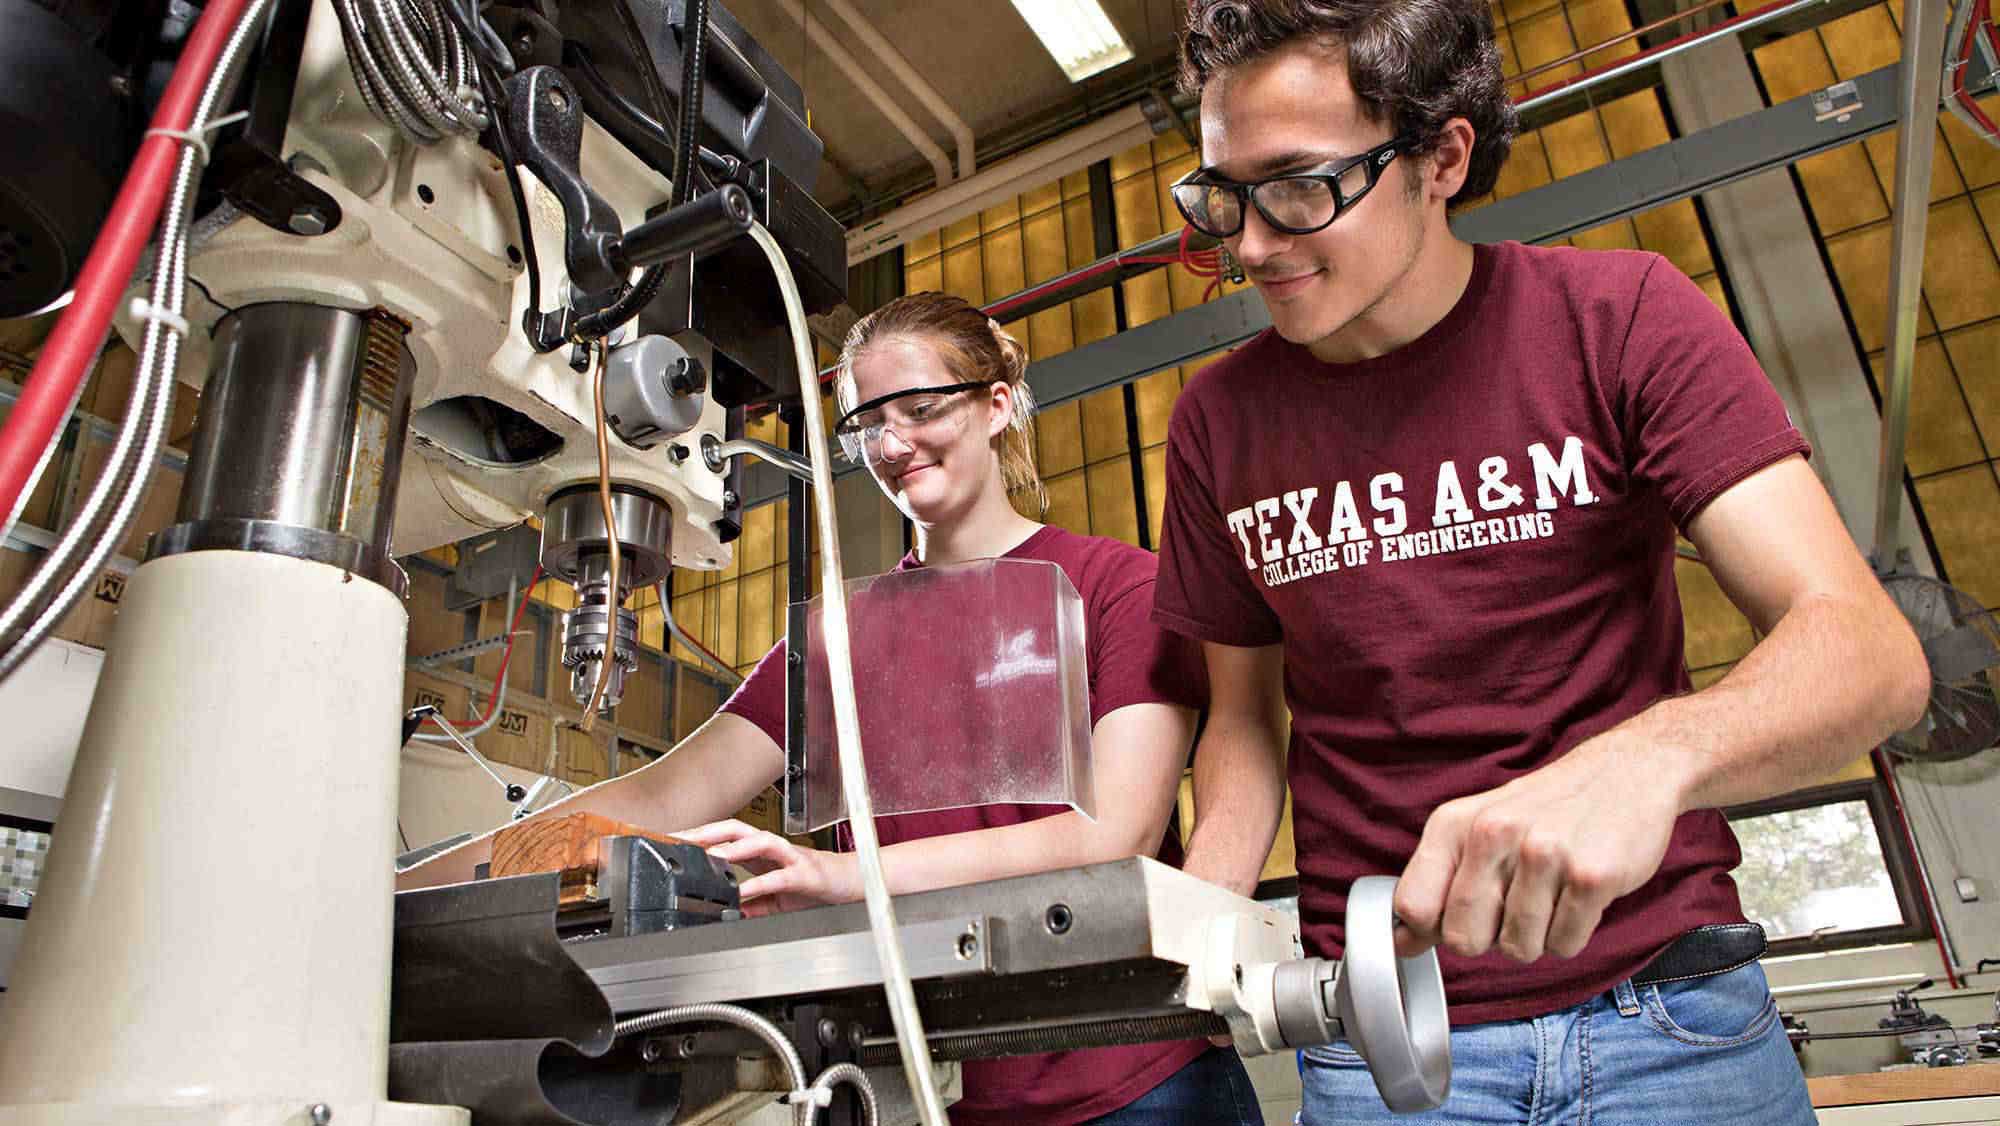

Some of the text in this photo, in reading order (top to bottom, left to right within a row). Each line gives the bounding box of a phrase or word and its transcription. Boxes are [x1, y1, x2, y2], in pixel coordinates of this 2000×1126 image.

[1227, 471, 1408, 570] TEXAS
[1263, 512, 1555, 587] COLLEGE OF ENGINEERING
